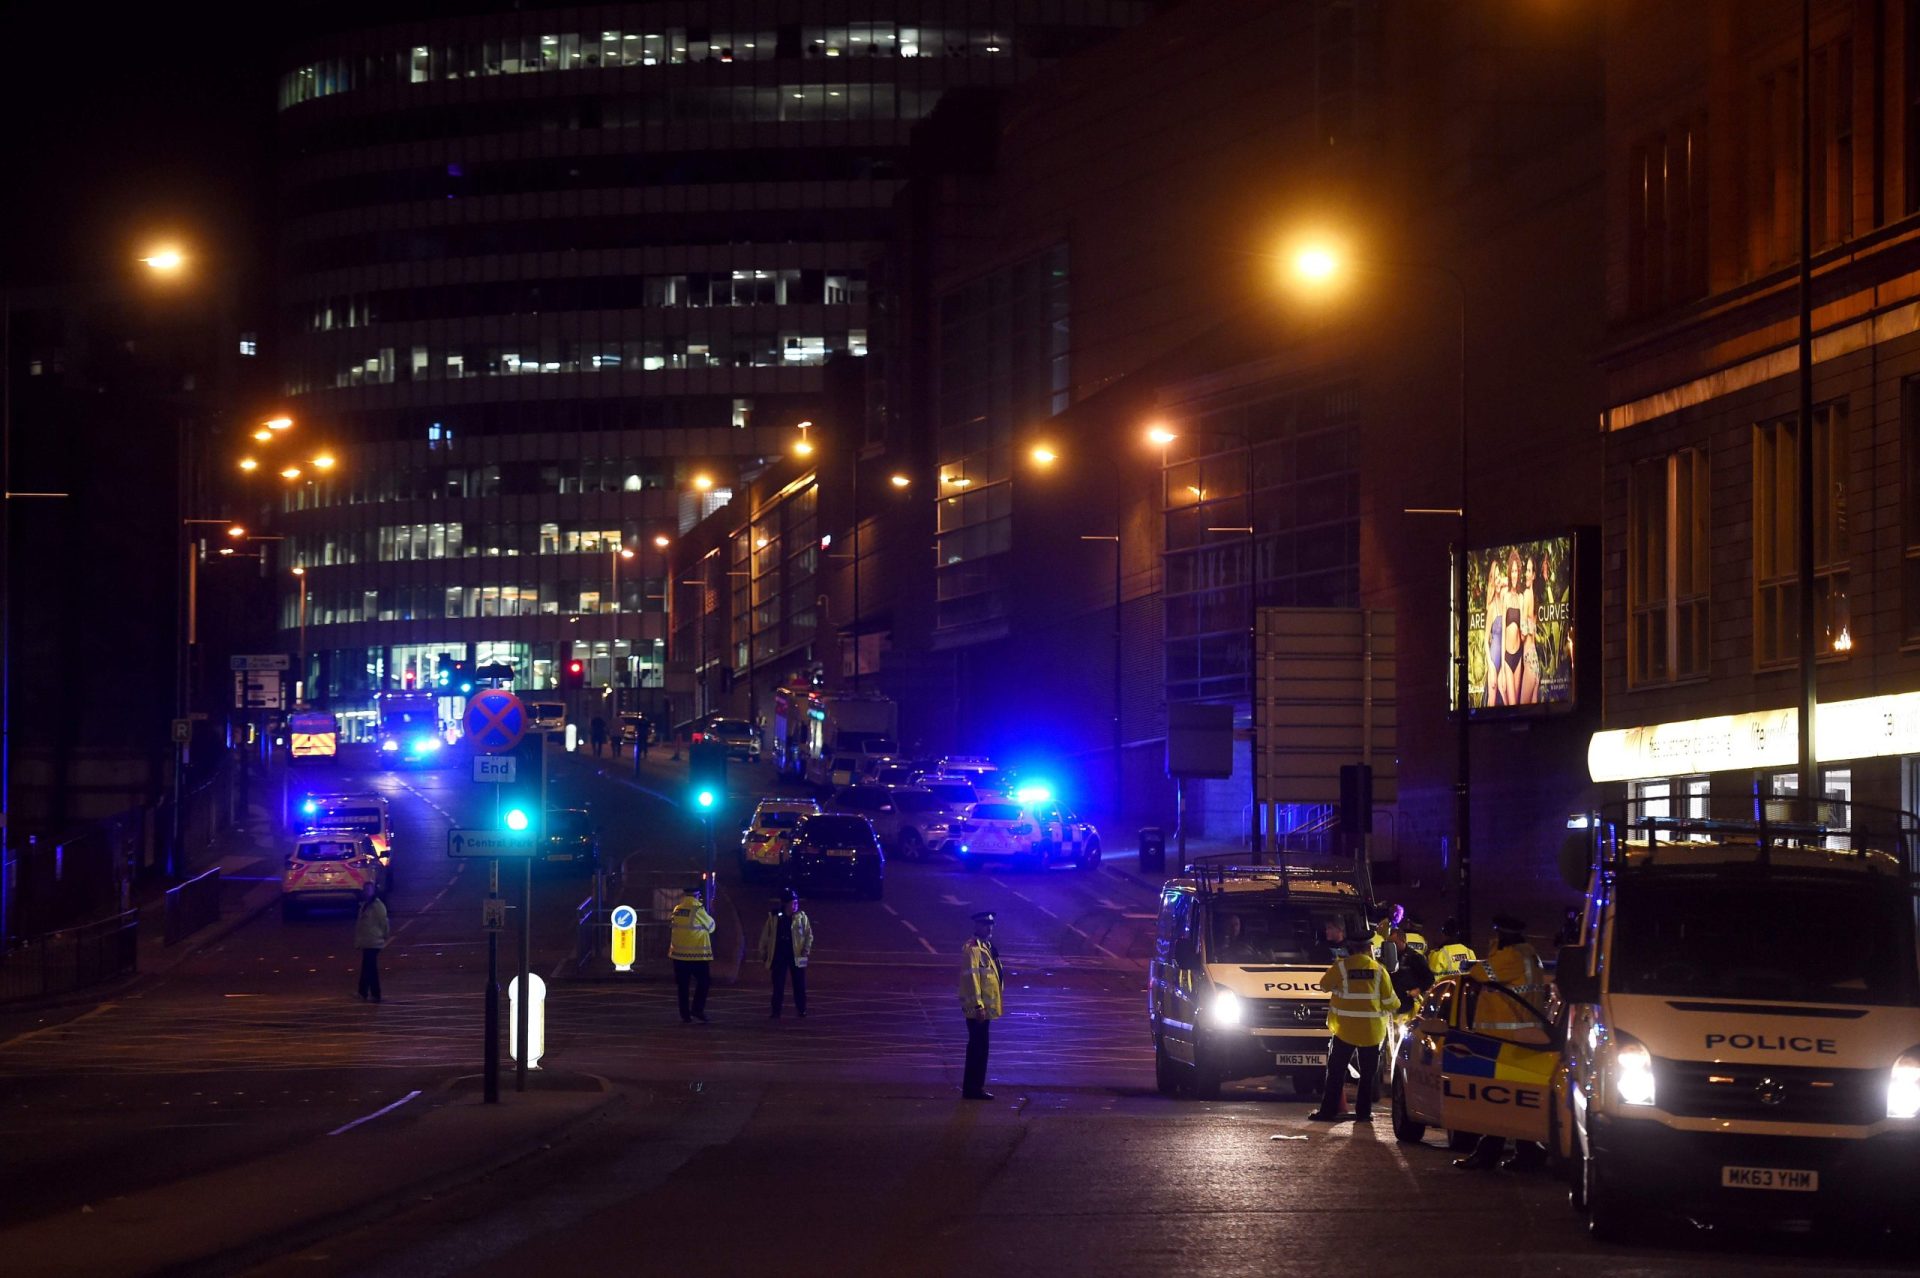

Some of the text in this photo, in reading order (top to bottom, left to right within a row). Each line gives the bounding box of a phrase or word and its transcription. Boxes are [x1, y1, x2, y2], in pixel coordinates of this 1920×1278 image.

[1469, 612, 1486, 630] ARE
[176, 723, 188, 737] R
[480, 761, 509, 774] End
[467, 837, 506, 848] Central
[1264, 983, 1322, 992] POLIC
[1705, 1034, 1837, 1054] POLICE
[1280, 1055, 1323, 1064] MK63 YHL
[1729, 1168, 1773, 1186] MK63
